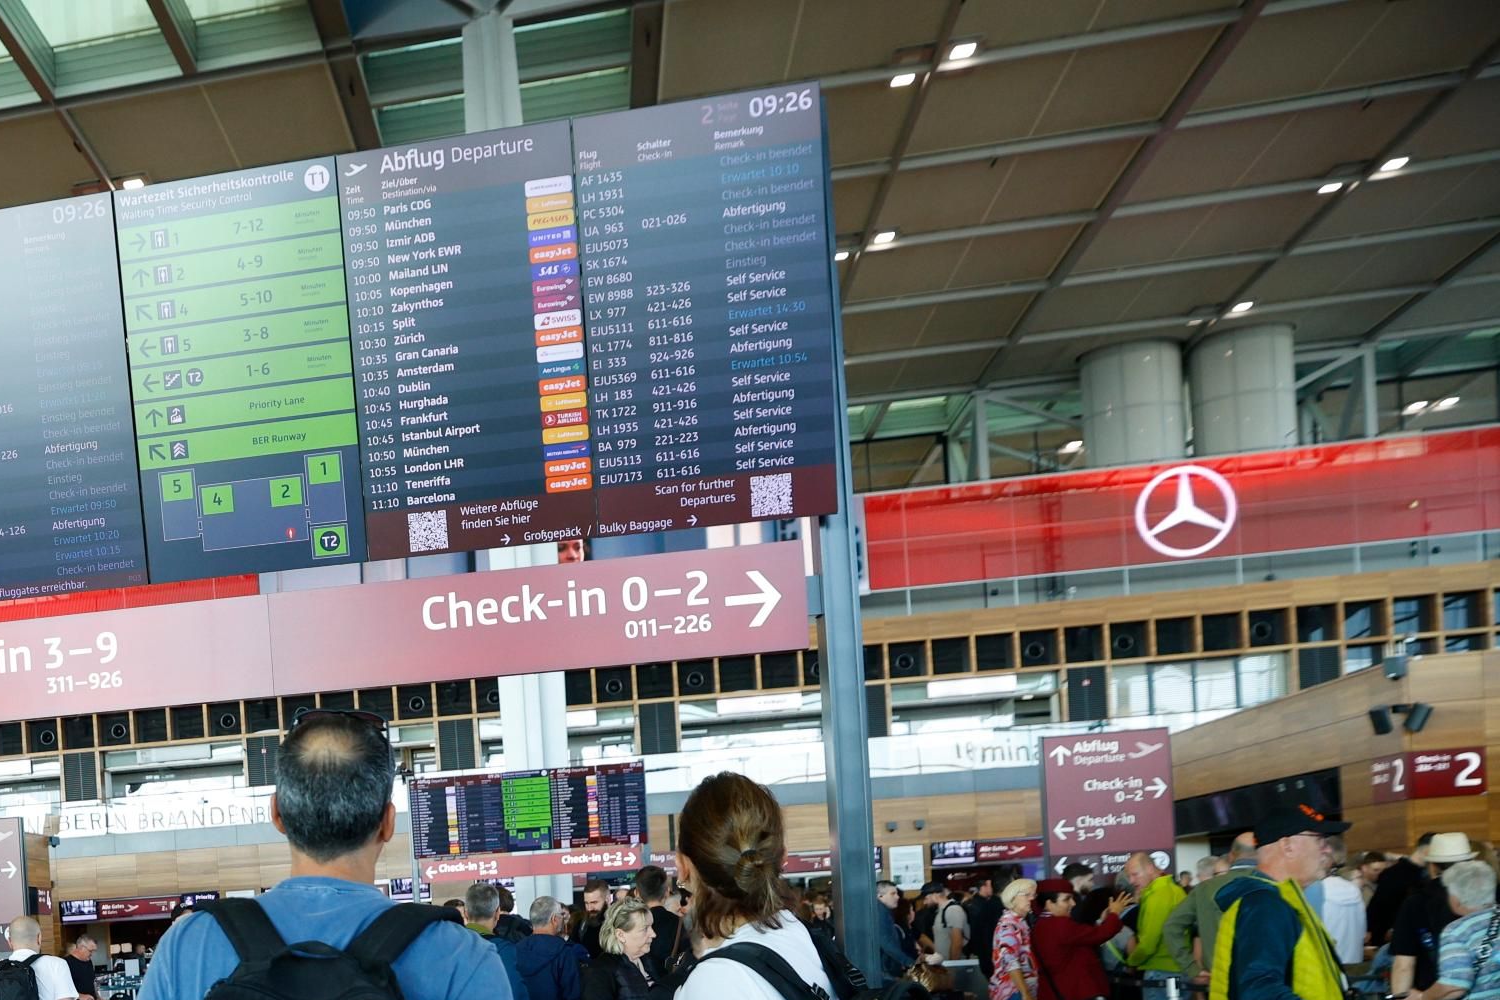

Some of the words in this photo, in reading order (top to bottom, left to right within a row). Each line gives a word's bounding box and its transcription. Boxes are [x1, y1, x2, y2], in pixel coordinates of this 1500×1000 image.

[748, 88, 813, 119] 09:26
[345, 185, 360, 194] Zeit
[380, 175, 418, 190] Ziel/über
[578, 149, 597, 161] Flug
[636, 137, 672, 151] Schalter
[713, 123, 763, 141] Bemerkung
[379, 147, 445, 174] Abflug
[451, 137, 534, 164] Departure
[119, 188, 174, 207] Wartezeit
[177, 168, 294, 198] Sicherheitskontrolle
[307, 170, 326, 186] T1
[51, 198, 106, 225] 09:26
[121, 207, 154, 222] Waiting
[157, 203, 178, 214] Time
[181, 197, 217, 213] Security
[219, 191, 252, 205] Control
[347, 207, 376, 221] 09:50
[382, 202, 408, 215] Paris
[410, 199, 431, 211] CDG
[234, 218, 264, 235] 7-12
[351, 256, 380, 269] 09:50
[387, 252, 410, 264] New
[412, 248, 435, 260] York
[438, 244, 461, 257] EWR
[583, 225, 599, 236] UA
[604, 222, 624, 234] 963
[641, 213, 687, 229] 021-026
[722, 199, 786, 220] Abfertigung
[237, 254, 263, 271] 4-9
[240, 289, 273, 306] 5-10
[243, 326, 269, 342] 3-8
[246, 362, 270, 377] 1-6
[249, 398, 282, 411] Priority
[284, 395, 305, 405] Lane
[366, 434, 394, 446] 10:45
[401, 427, 443, 442] Istanbul
[444, 422, 480, 438] Airport
[595, 408, 609, 419] TK
[611, 405, 636, 417] 1722
[652, 398, 697, 412] 911-916
[732, 387, 795, 405] Abfertigung
[252, 436, 269, 445] BER
[271, 431, 307, 445] Runway
[172, 478, 182, 493] 5
[319, 461, 327, 475] 1
[371, 498, 399, 510] 11:10
[406, 490, 455, 506] Barcelona
[549, 475, 587, 490] easyJet
[599, 470, 642, 484] EJU7173
[656, 464, 700, 478] 611-616
[735, 458, 755, 469] Self
[757, 455, 794, 468] Service
[212, 492, 222, 505] 4
[280, 484, 290, 498] 2
[460, 503, 497, 516] Weitere
[499, 497, 538, 514] Abflüge
[51, 515, 105, 532] Abfertigung
[523, 525, 581, 542] Großgepäck
[599, 521, 627, 533] Bulky
[629, 518, 673, 530] Baggage
[321, 535, 337, 547] T2
[41, 579, 87, 593] erreichbar.
[422, 580, 607, 631] Check-in
[622, 570, 709, 612] 0–2
[624, 614, 712, 639] 011–226
[43, 631, 118, 669] 3–9
[46, 671, 123, 695] 311–926
[1073, 740, 1119, 753] Abflug
[1073, 753, 1126, 766] Departure
[1454, 752, 1482, 787] 2
[1084, 776, 1143, 791] Check-in
[1114, 790, 1144, 803] 0–2
[1076, 813, 1135, 828] Check-in
[1077, 828, 1105, 841] 3–9
[438, 861, 477, 873] Check-in
[561, 853, 601, 865] Check-in
[602, 852, 622, 862] 0–2
